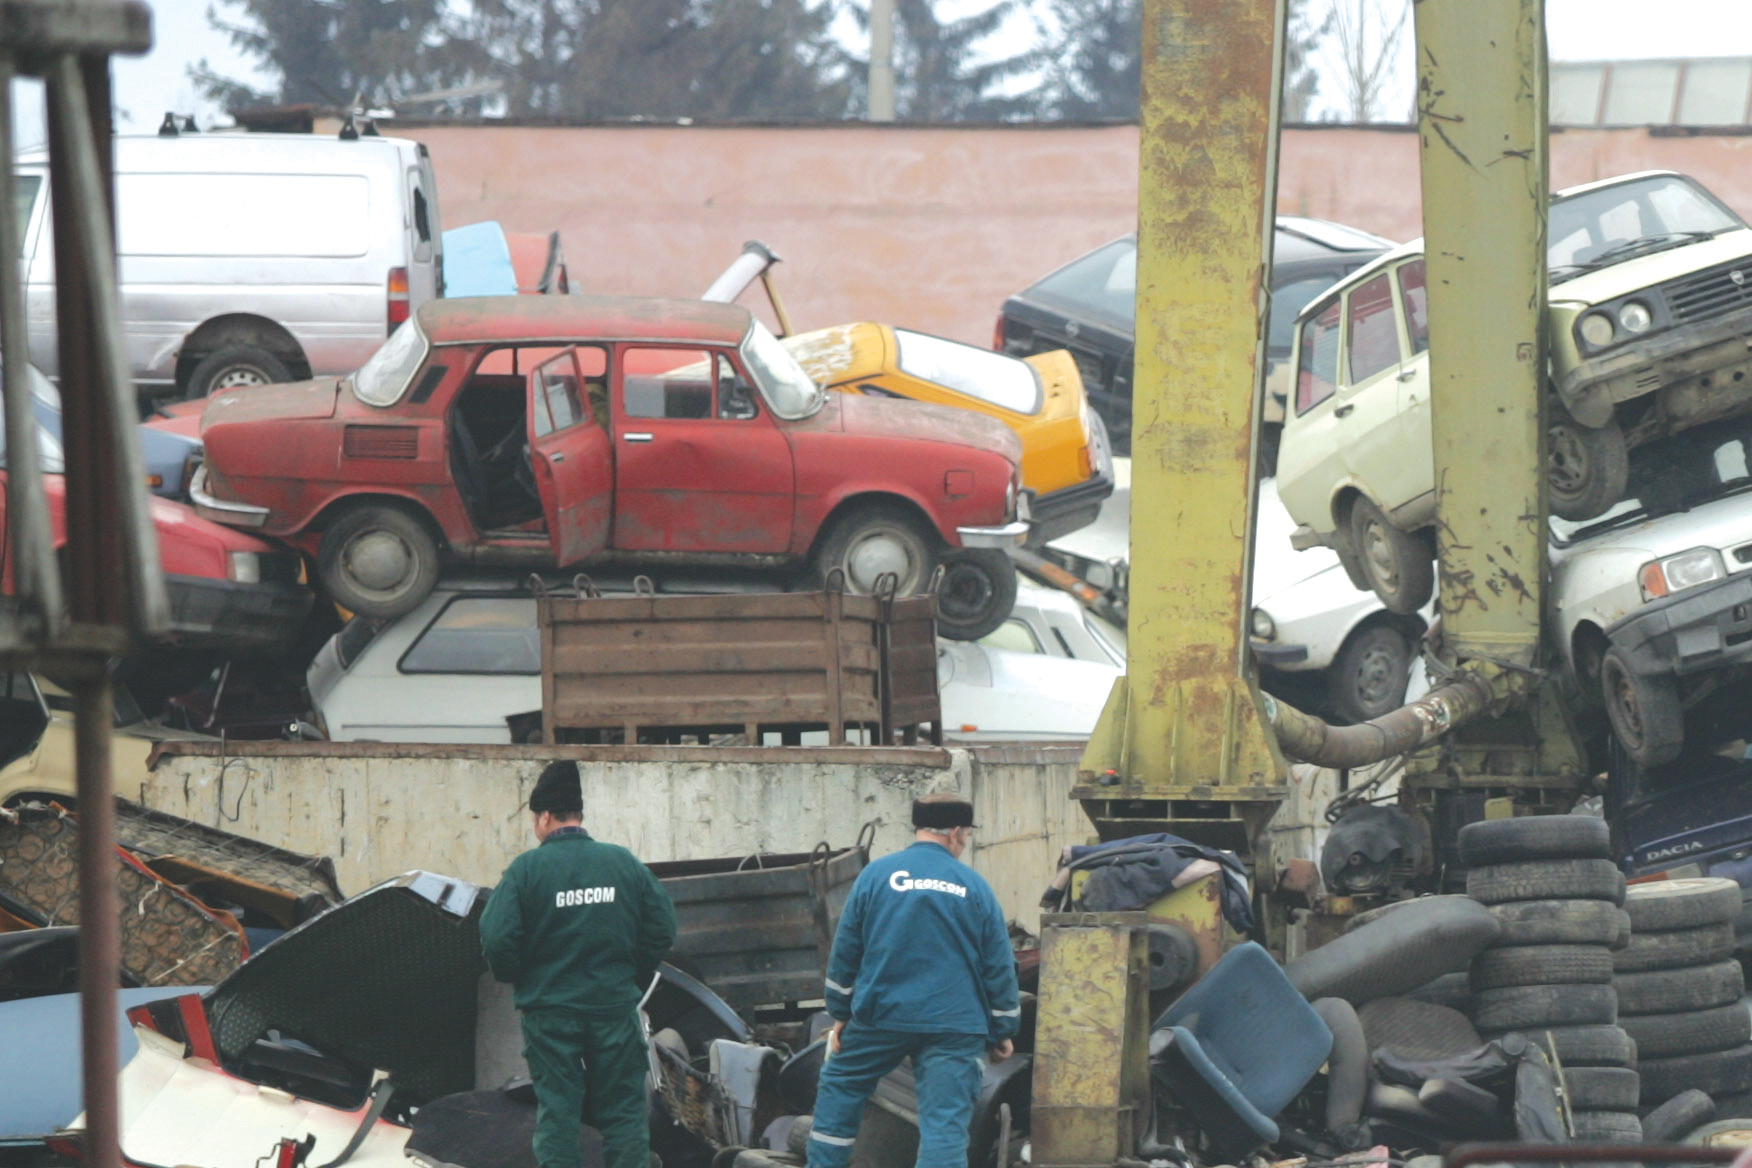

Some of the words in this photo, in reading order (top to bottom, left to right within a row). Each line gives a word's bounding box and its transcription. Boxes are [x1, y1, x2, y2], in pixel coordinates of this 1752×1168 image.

[1646, 841, 1704, 861] DACIA
[555, 886, 616, 908] GOSCOM
[914, 878, 967, 898] GOSCOM
